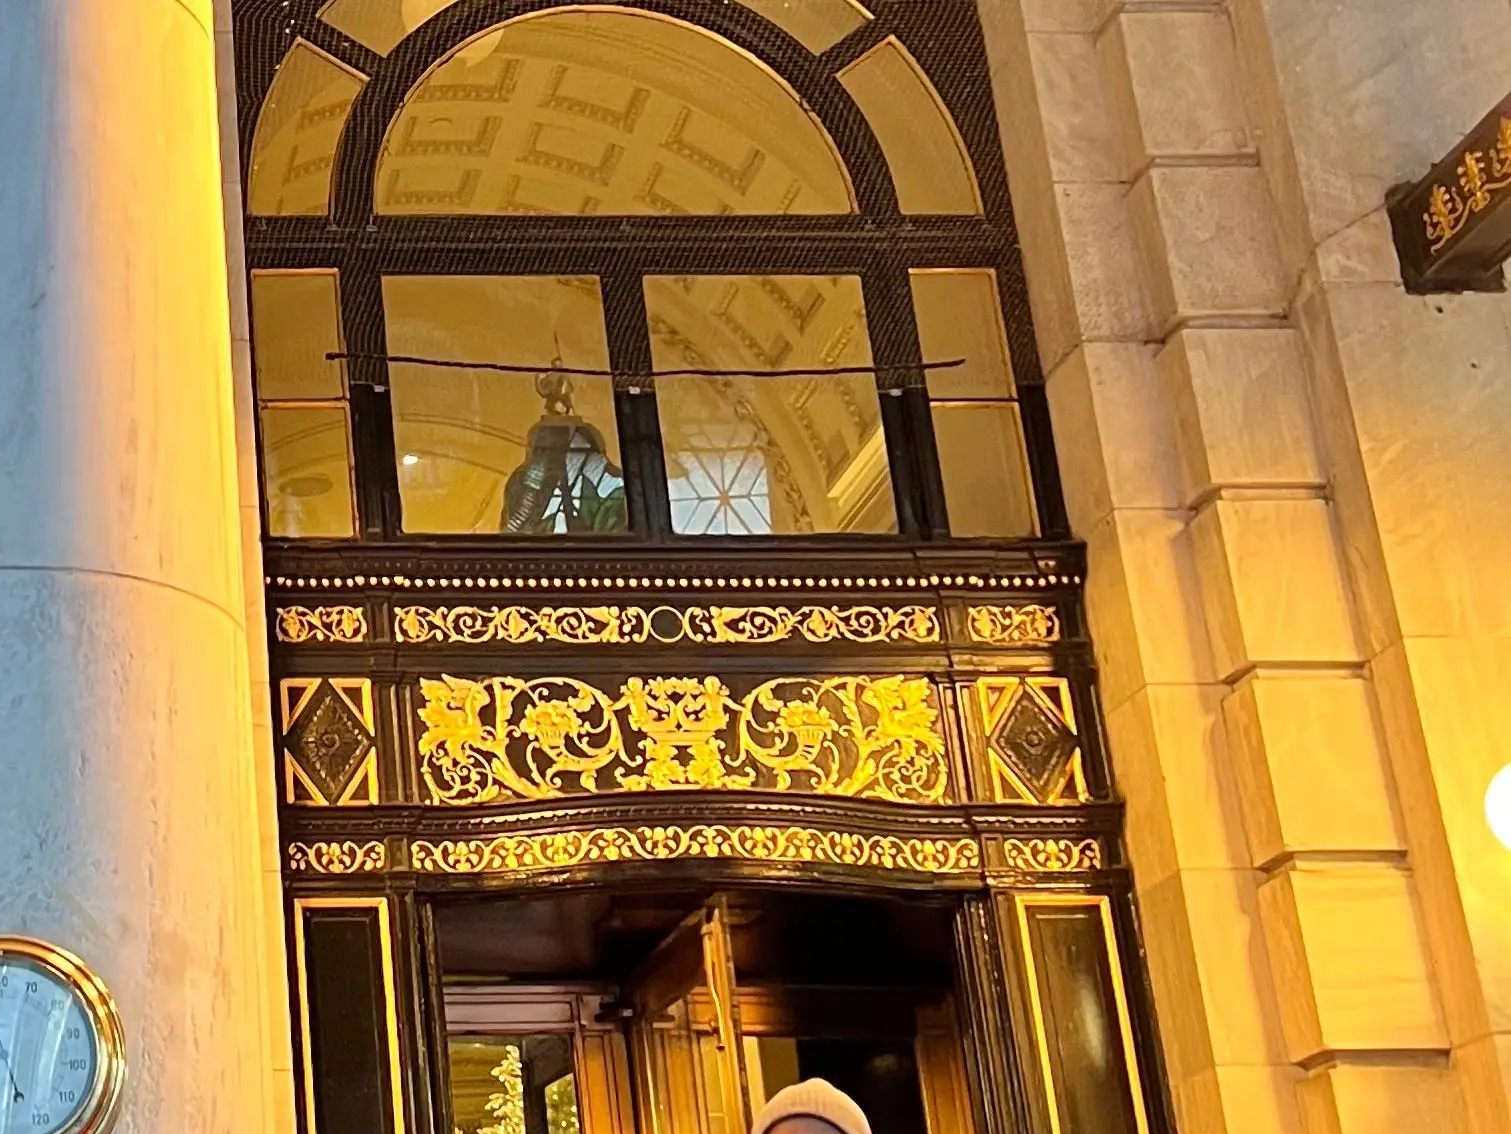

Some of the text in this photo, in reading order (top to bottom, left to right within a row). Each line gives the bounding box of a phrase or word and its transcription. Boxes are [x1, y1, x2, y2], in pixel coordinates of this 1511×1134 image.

[25, 981, 38, 994] 70
[50, 999, 65, 1012] 80
[66, 1028, 80, 1040] 90
[68, 1058, 87, 1071] 100
[59, 1091, 76, 1103] 110
[31, 1112, 50, 1126] 120
